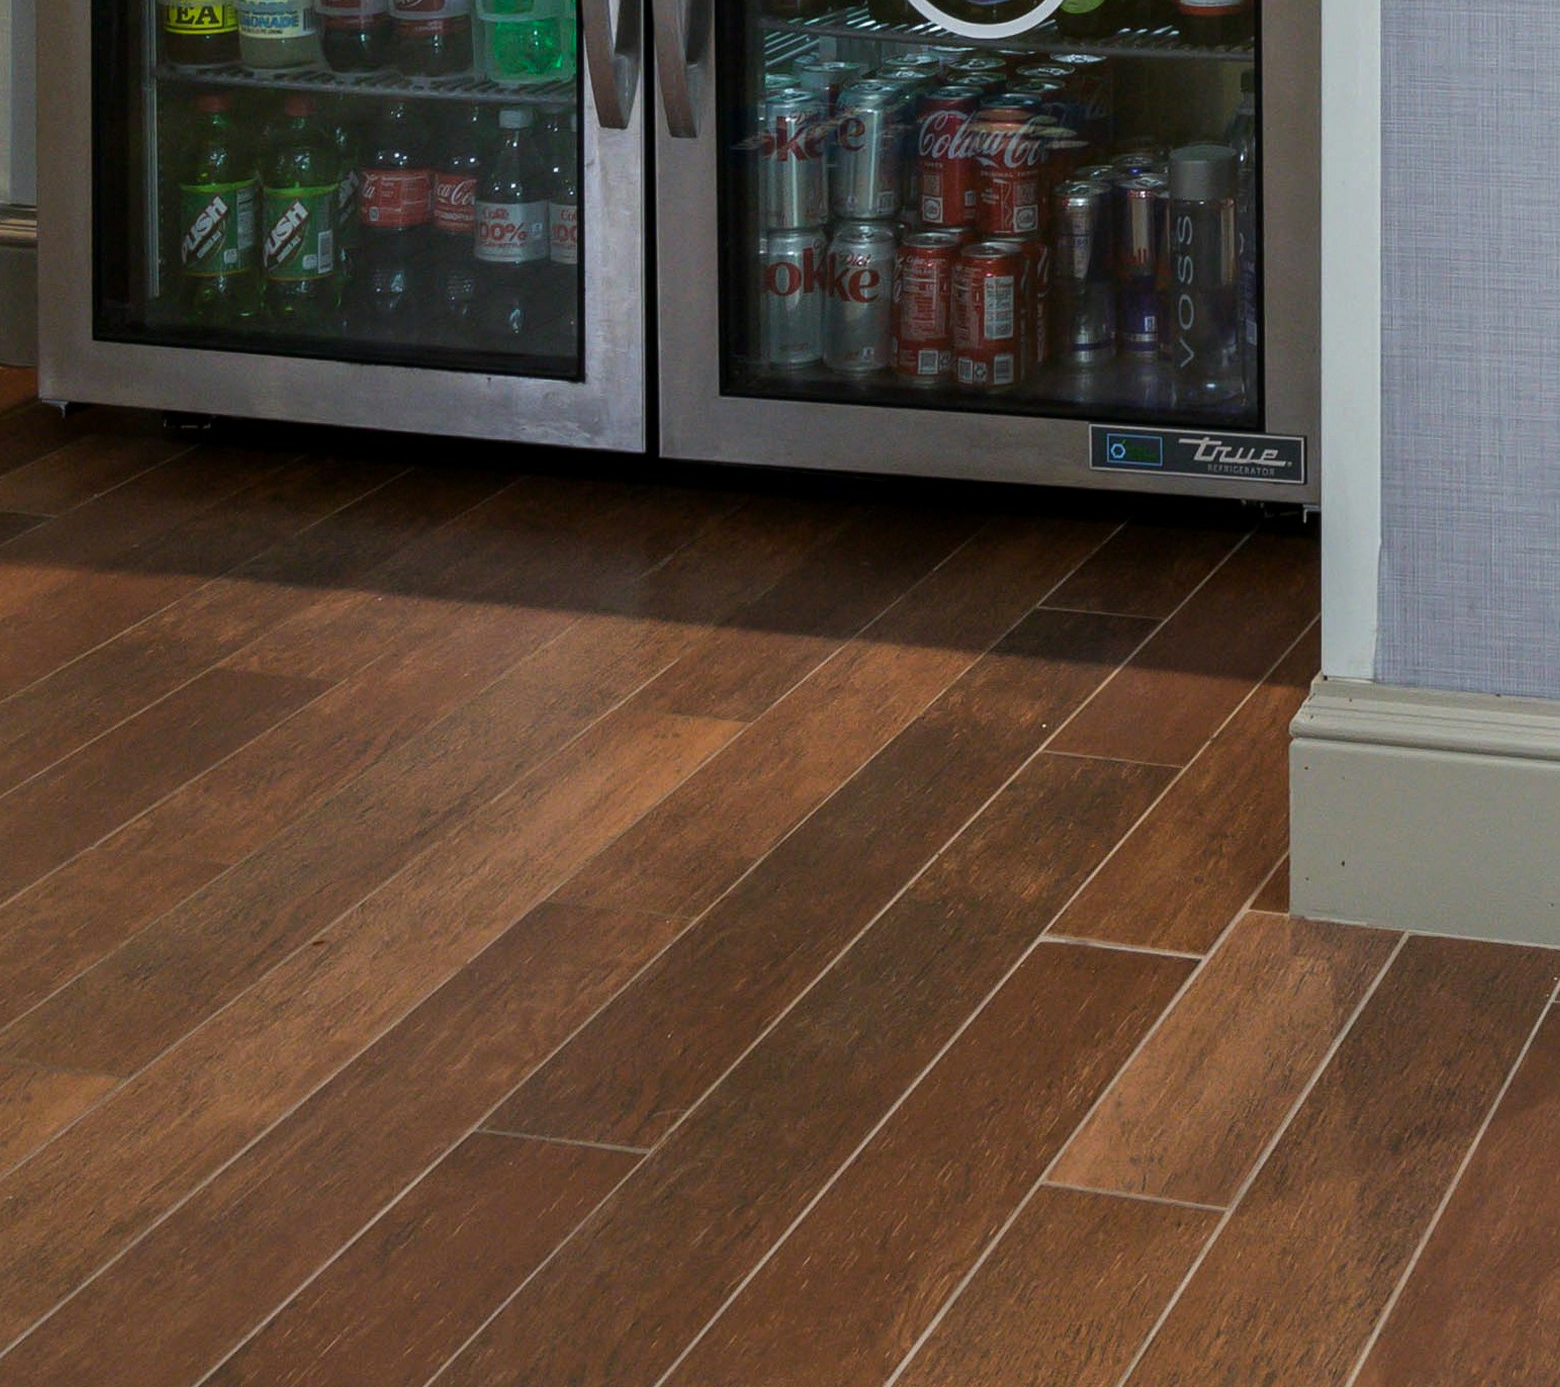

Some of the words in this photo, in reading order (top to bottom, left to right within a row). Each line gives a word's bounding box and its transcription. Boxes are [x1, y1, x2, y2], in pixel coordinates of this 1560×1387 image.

[1177, 214, 1195, 369] VOSS
[1178, 436, 1287, 468] true
[1207, 463, 1276, 476] REFRIGERATOR
